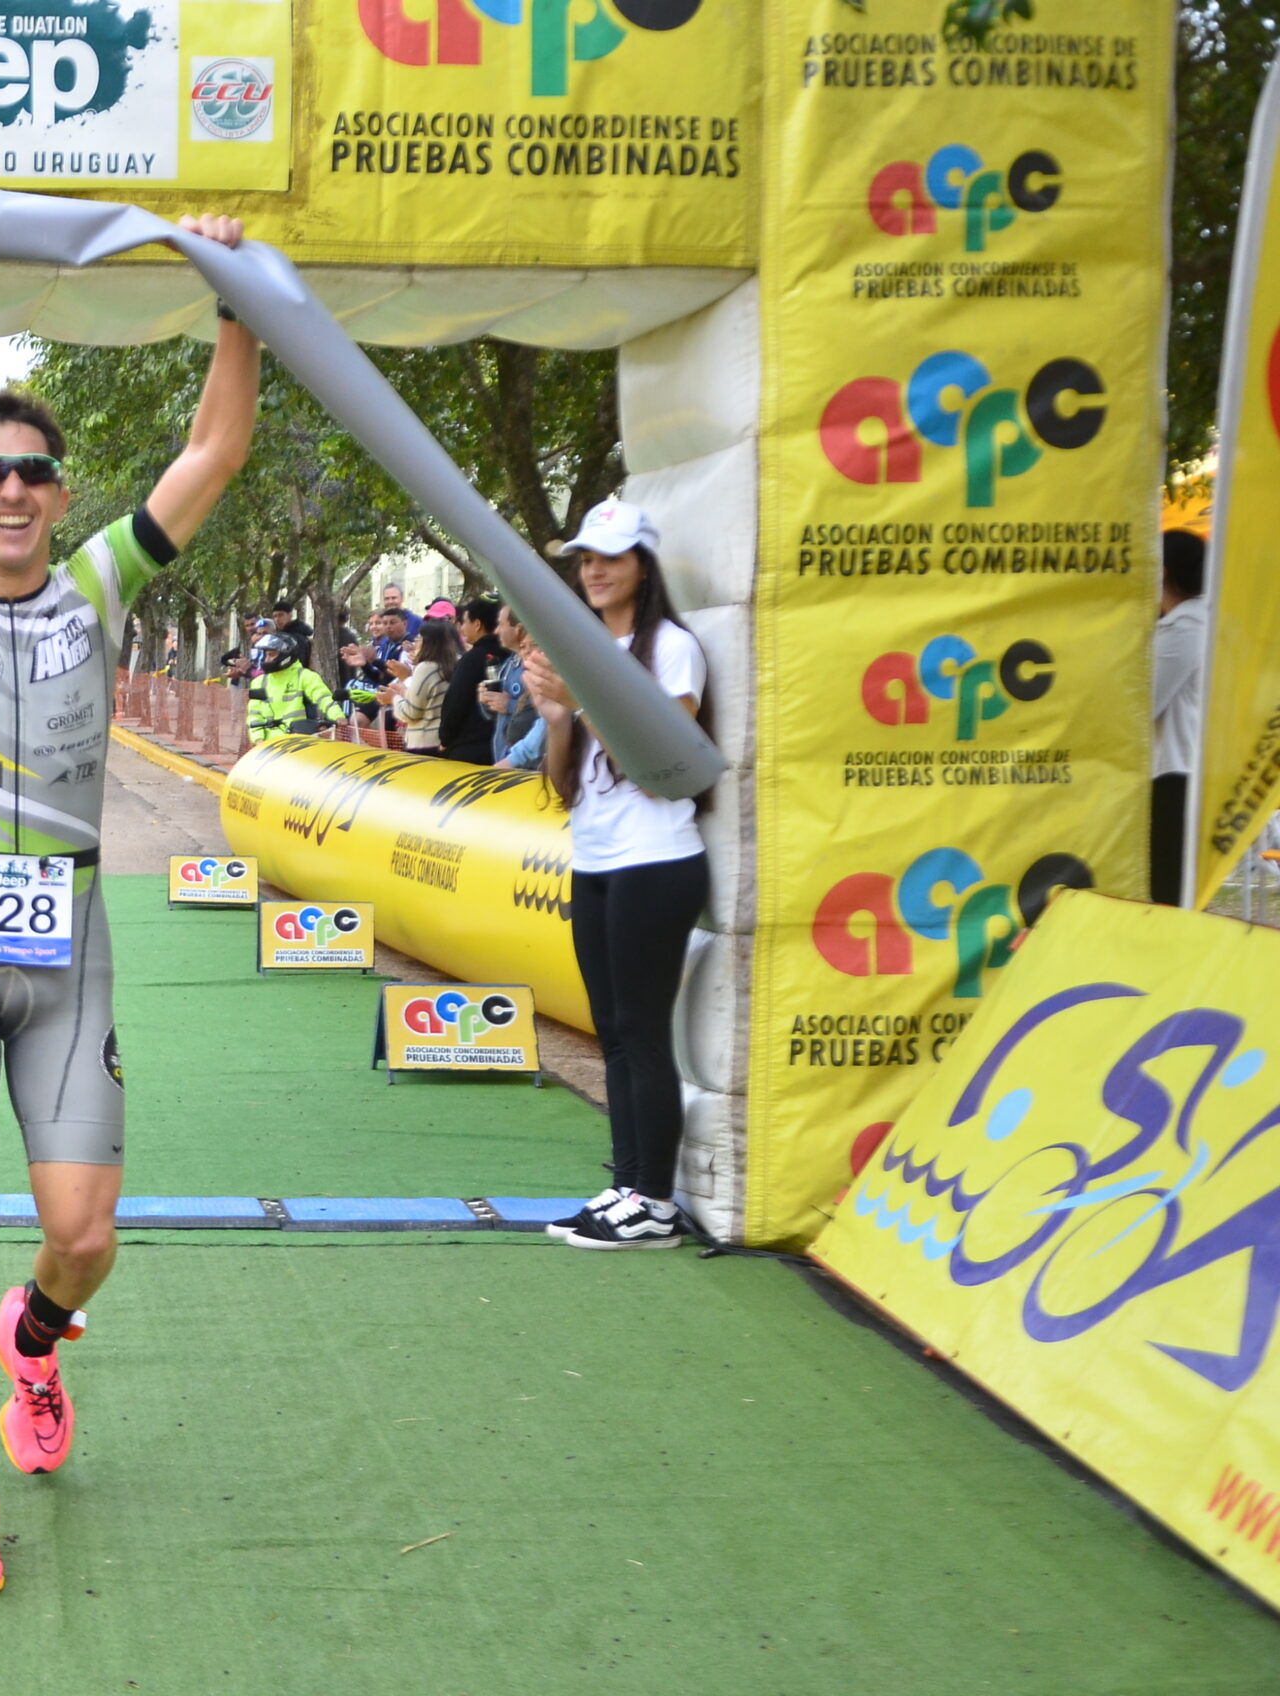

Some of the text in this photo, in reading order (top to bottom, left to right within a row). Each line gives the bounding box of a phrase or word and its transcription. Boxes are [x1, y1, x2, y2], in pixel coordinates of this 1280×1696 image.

[12, 15, 88, 35] DUATLON
[804, 33, 936, 56] ASOCIACION
[1114, 36, 1137, 57] DE
[802, 58, 1138, 90] PRUEBAS COMBINADAS
[191, 83, 273, 101] CCU
[333, 111, 739, 142] ASOCIACION CONCORDIENSE DE
[33, 151, 157, 174] URUGUAY
[330, 139, 741, 178] PRUEBAS COMBINADAS
[853, 262, 1078, 278] ASOCIACION CONCORDIENSE DE
[852, 278, 1082, 298] PRUEBAS COMBINADAS
[800, 522, 1132, 546] ASOCIACION CONCORDIENSE DE
[798, 546, 1132, 576] PRUEBAS COMBINADAS
[844, 750, 1071, 765] ASOCIACION CONCORDIENSE DE
[843, 765, 1072, 787] PRUEBAS COMBINADAS
[791, 1014, 921, 1036] ASOCIACION
[406, 1053, 524, 1064] PRUEBAS COMBINADAS
[789, 1037, 920, 1067] PRUEBAS
